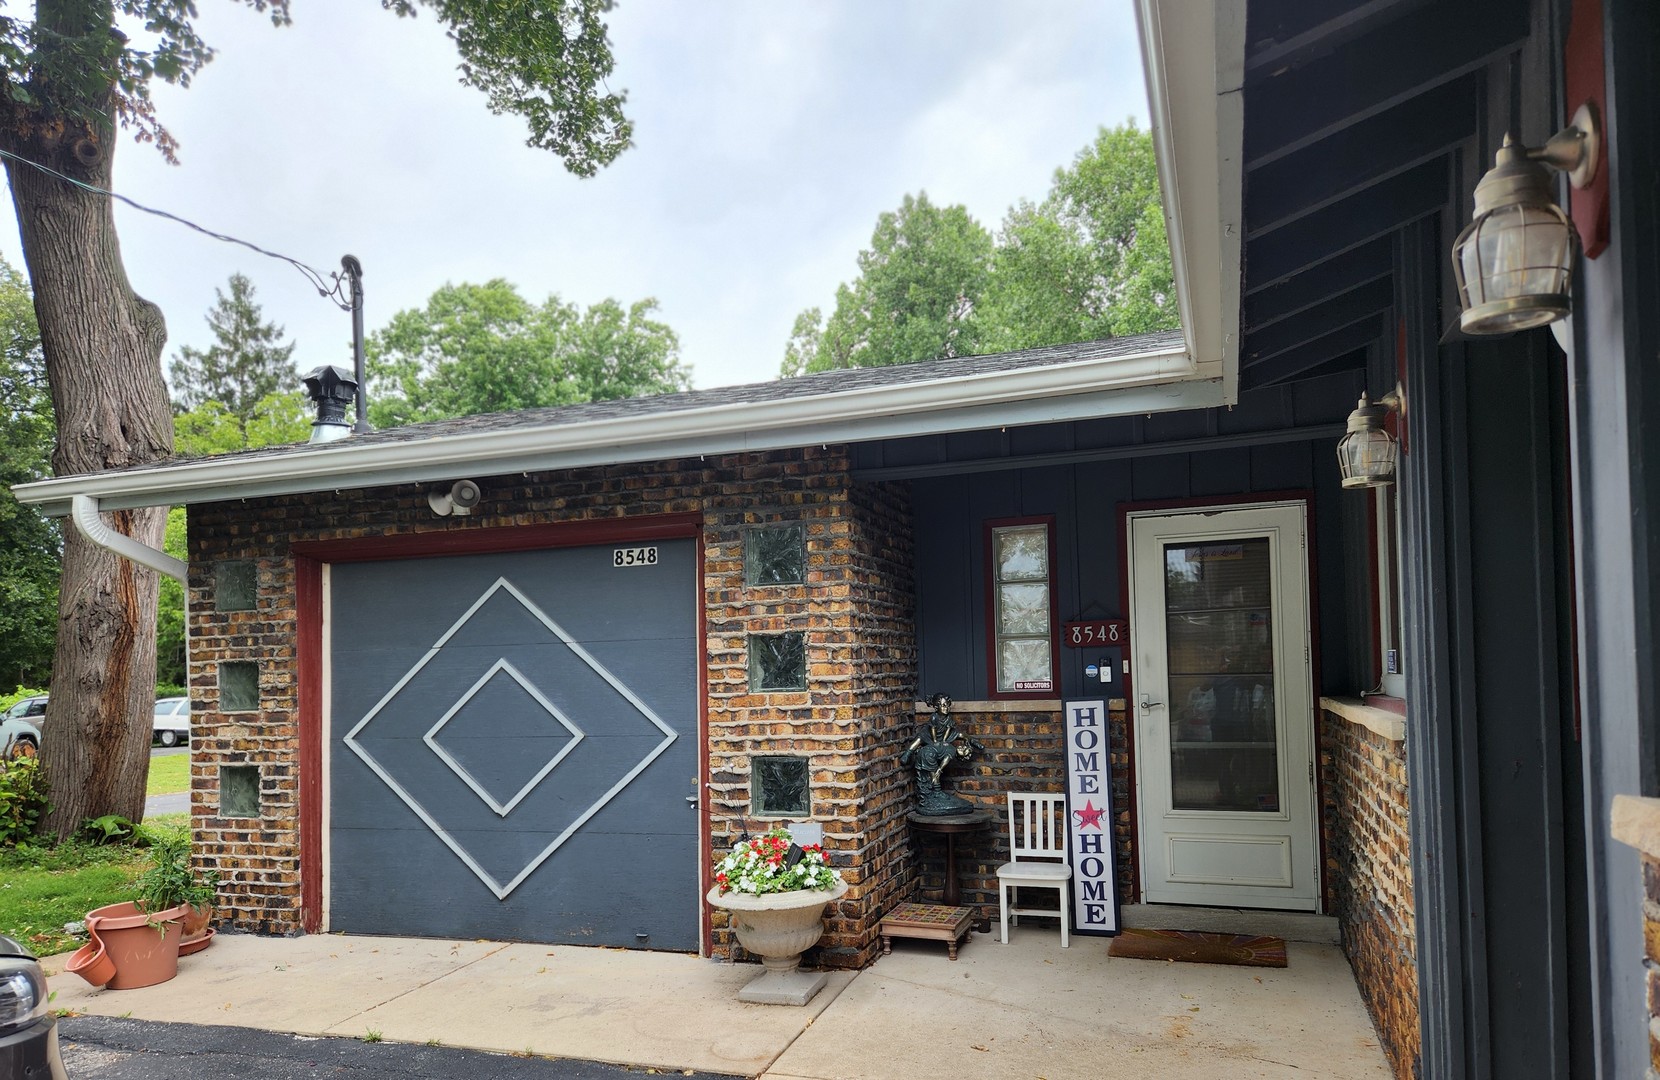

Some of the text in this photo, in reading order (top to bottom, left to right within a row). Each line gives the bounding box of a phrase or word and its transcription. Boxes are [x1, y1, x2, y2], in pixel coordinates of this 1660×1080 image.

[614, 547, 657, 566] 8548
[1071, 624, 1119, 644] 8548
[1072, 706, 1100, 795] HOME
[1072, 807, 1107, 828] Sweet
[1078, 833, 1108, 925] HOME
